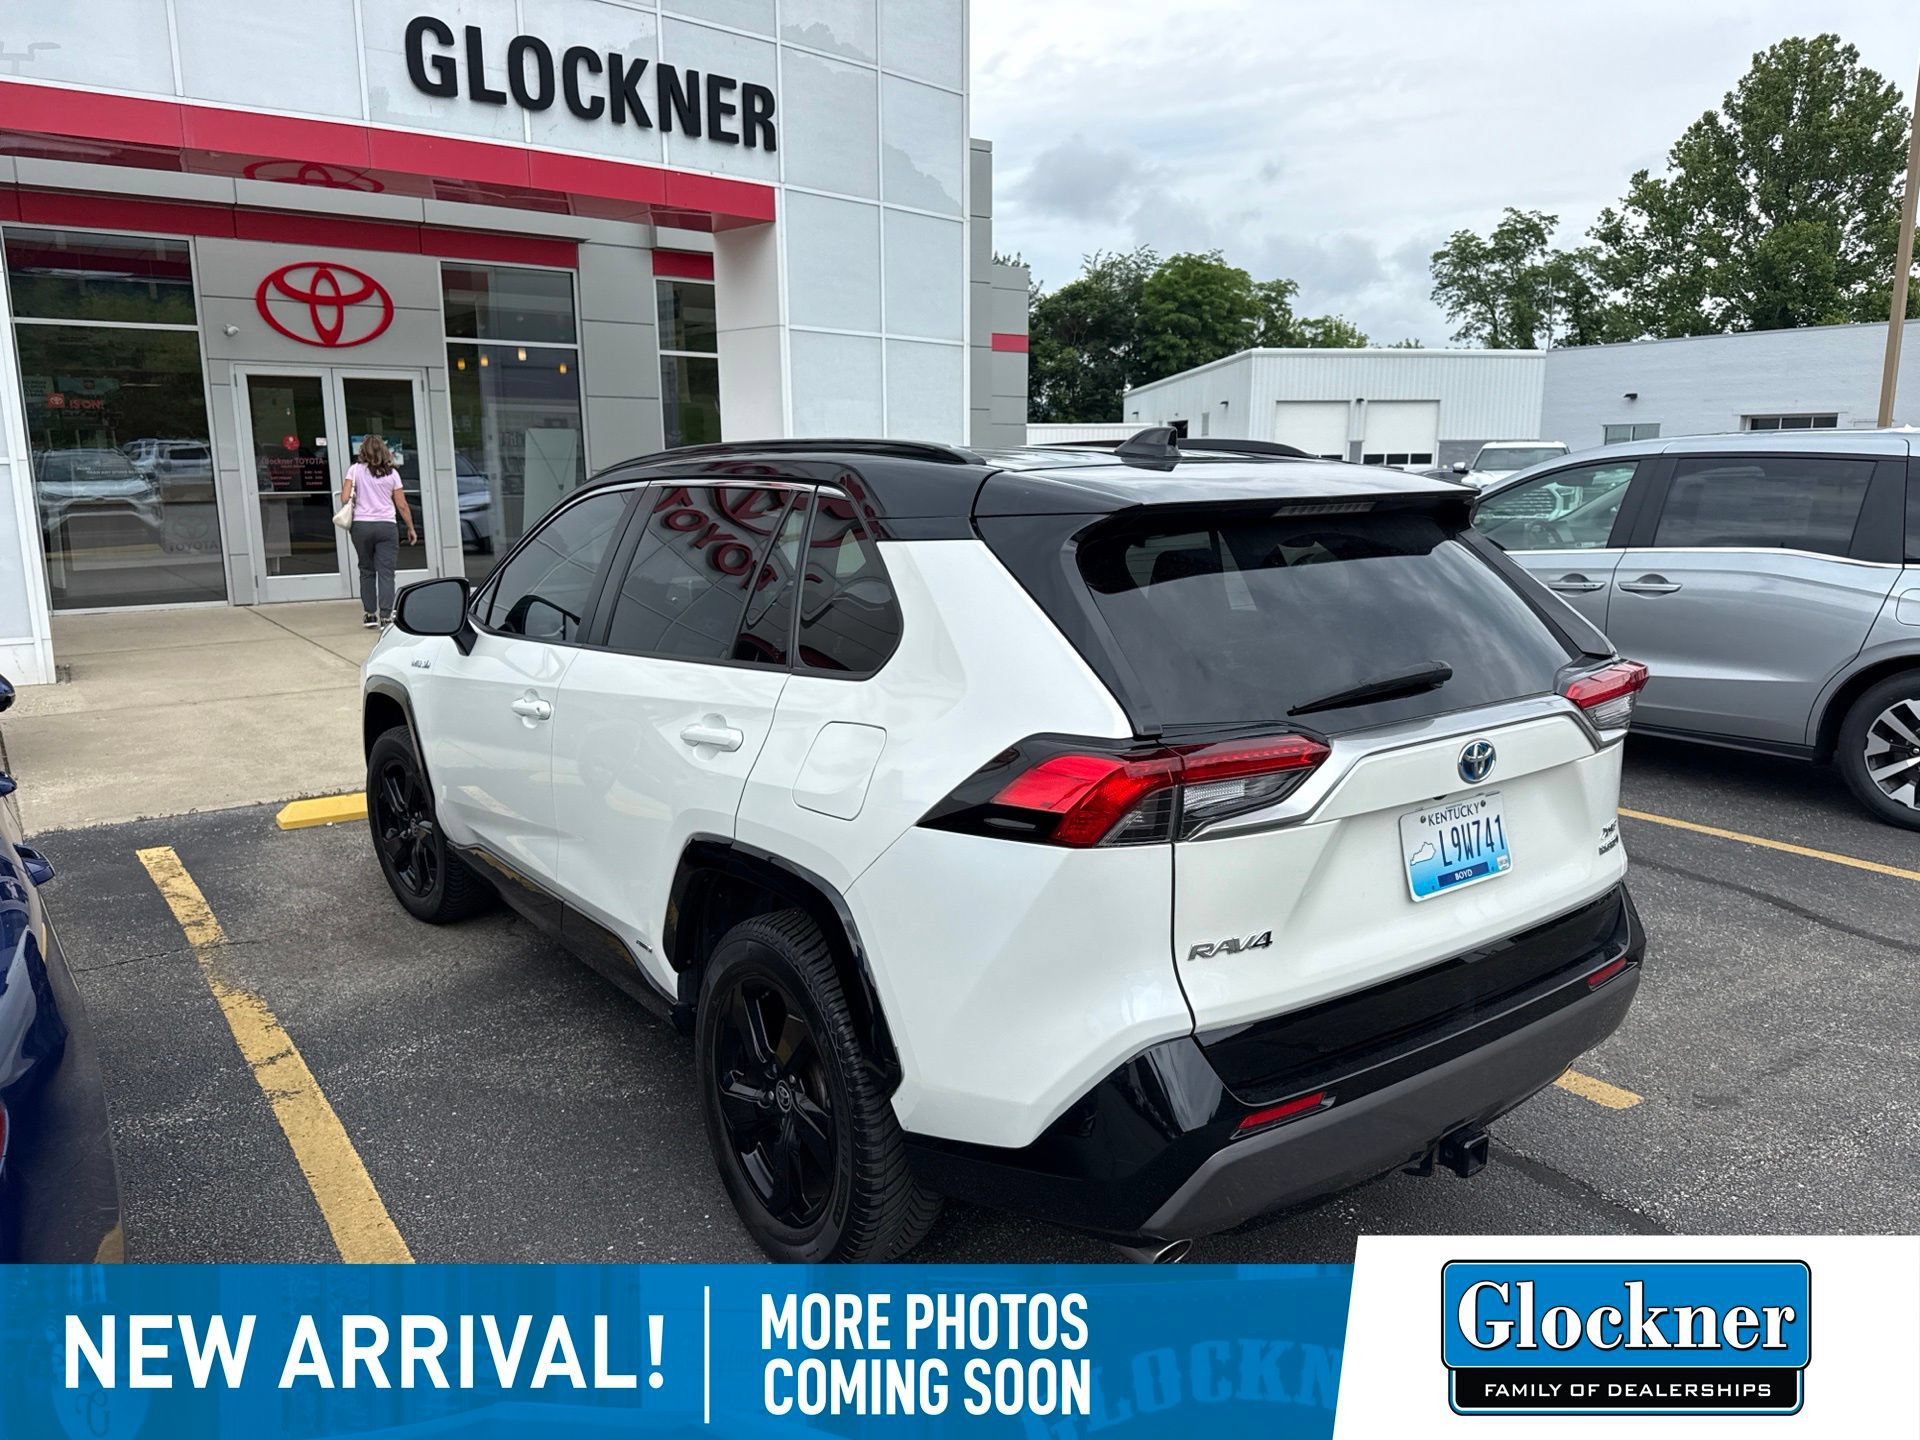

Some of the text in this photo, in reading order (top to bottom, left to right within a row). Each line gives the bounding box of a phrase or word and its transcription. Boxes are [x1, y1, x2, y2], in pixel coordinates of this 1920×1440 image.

[405, 16, 777, 153] GLOCKNER
[294, 456, 324, 465] TOYOTA
[1428, 803, 1480, 826] KENTUCKY
[1438, 815, 1505, 867] L9W741
[1454, 868, 1473, 881] BOYD
[1187, 930, 1273, 961] RAV4
